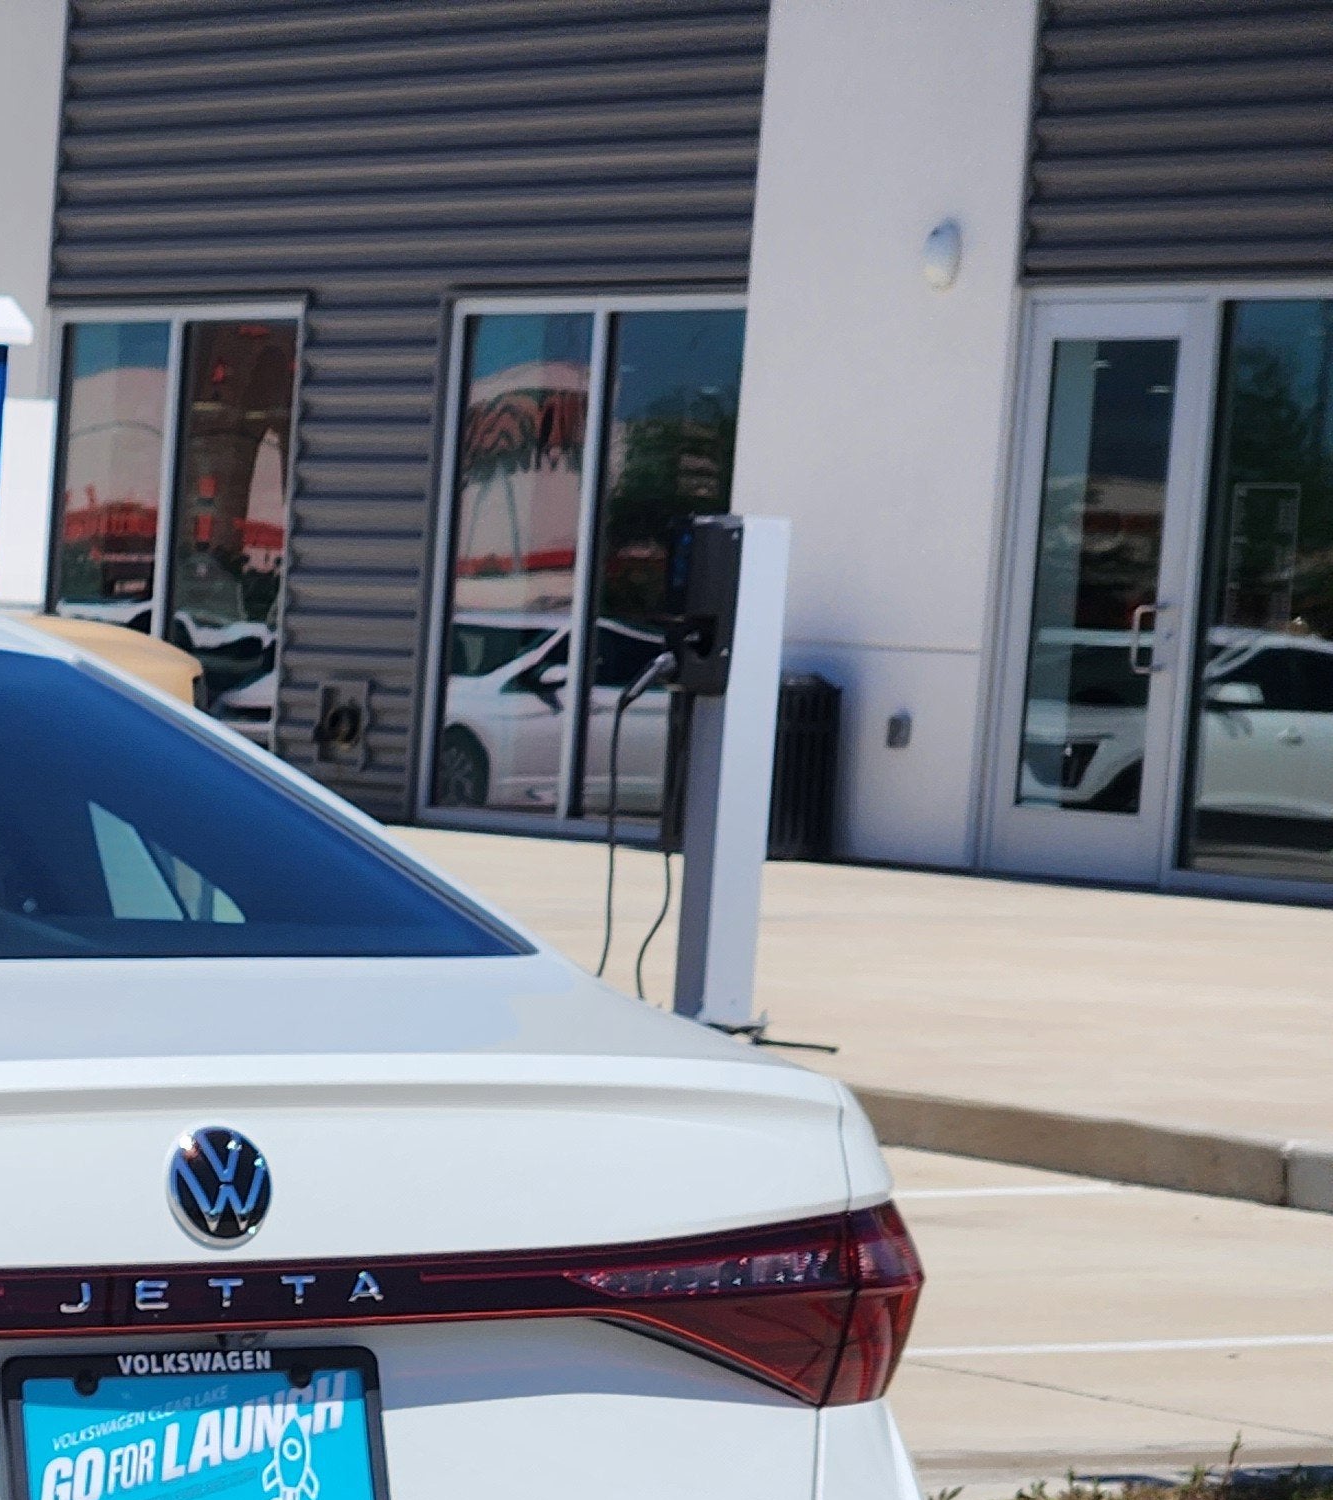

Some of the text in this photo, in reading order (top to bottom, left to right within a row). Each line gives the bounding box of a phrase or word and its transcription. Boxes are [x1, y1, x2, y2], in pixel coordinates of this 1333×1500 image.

[169, 1126, 271, 1247] VW
[60, 1271, 384, 1315] JETTA
[117, 1350, 273, 1376] VOLKSWAGEN
[52, 1411, 146, 1451] VOLKSWAGEN
[107, 1438, 156, 1496] FOR
[161, 1371, 347, 1482] LAUNCH
